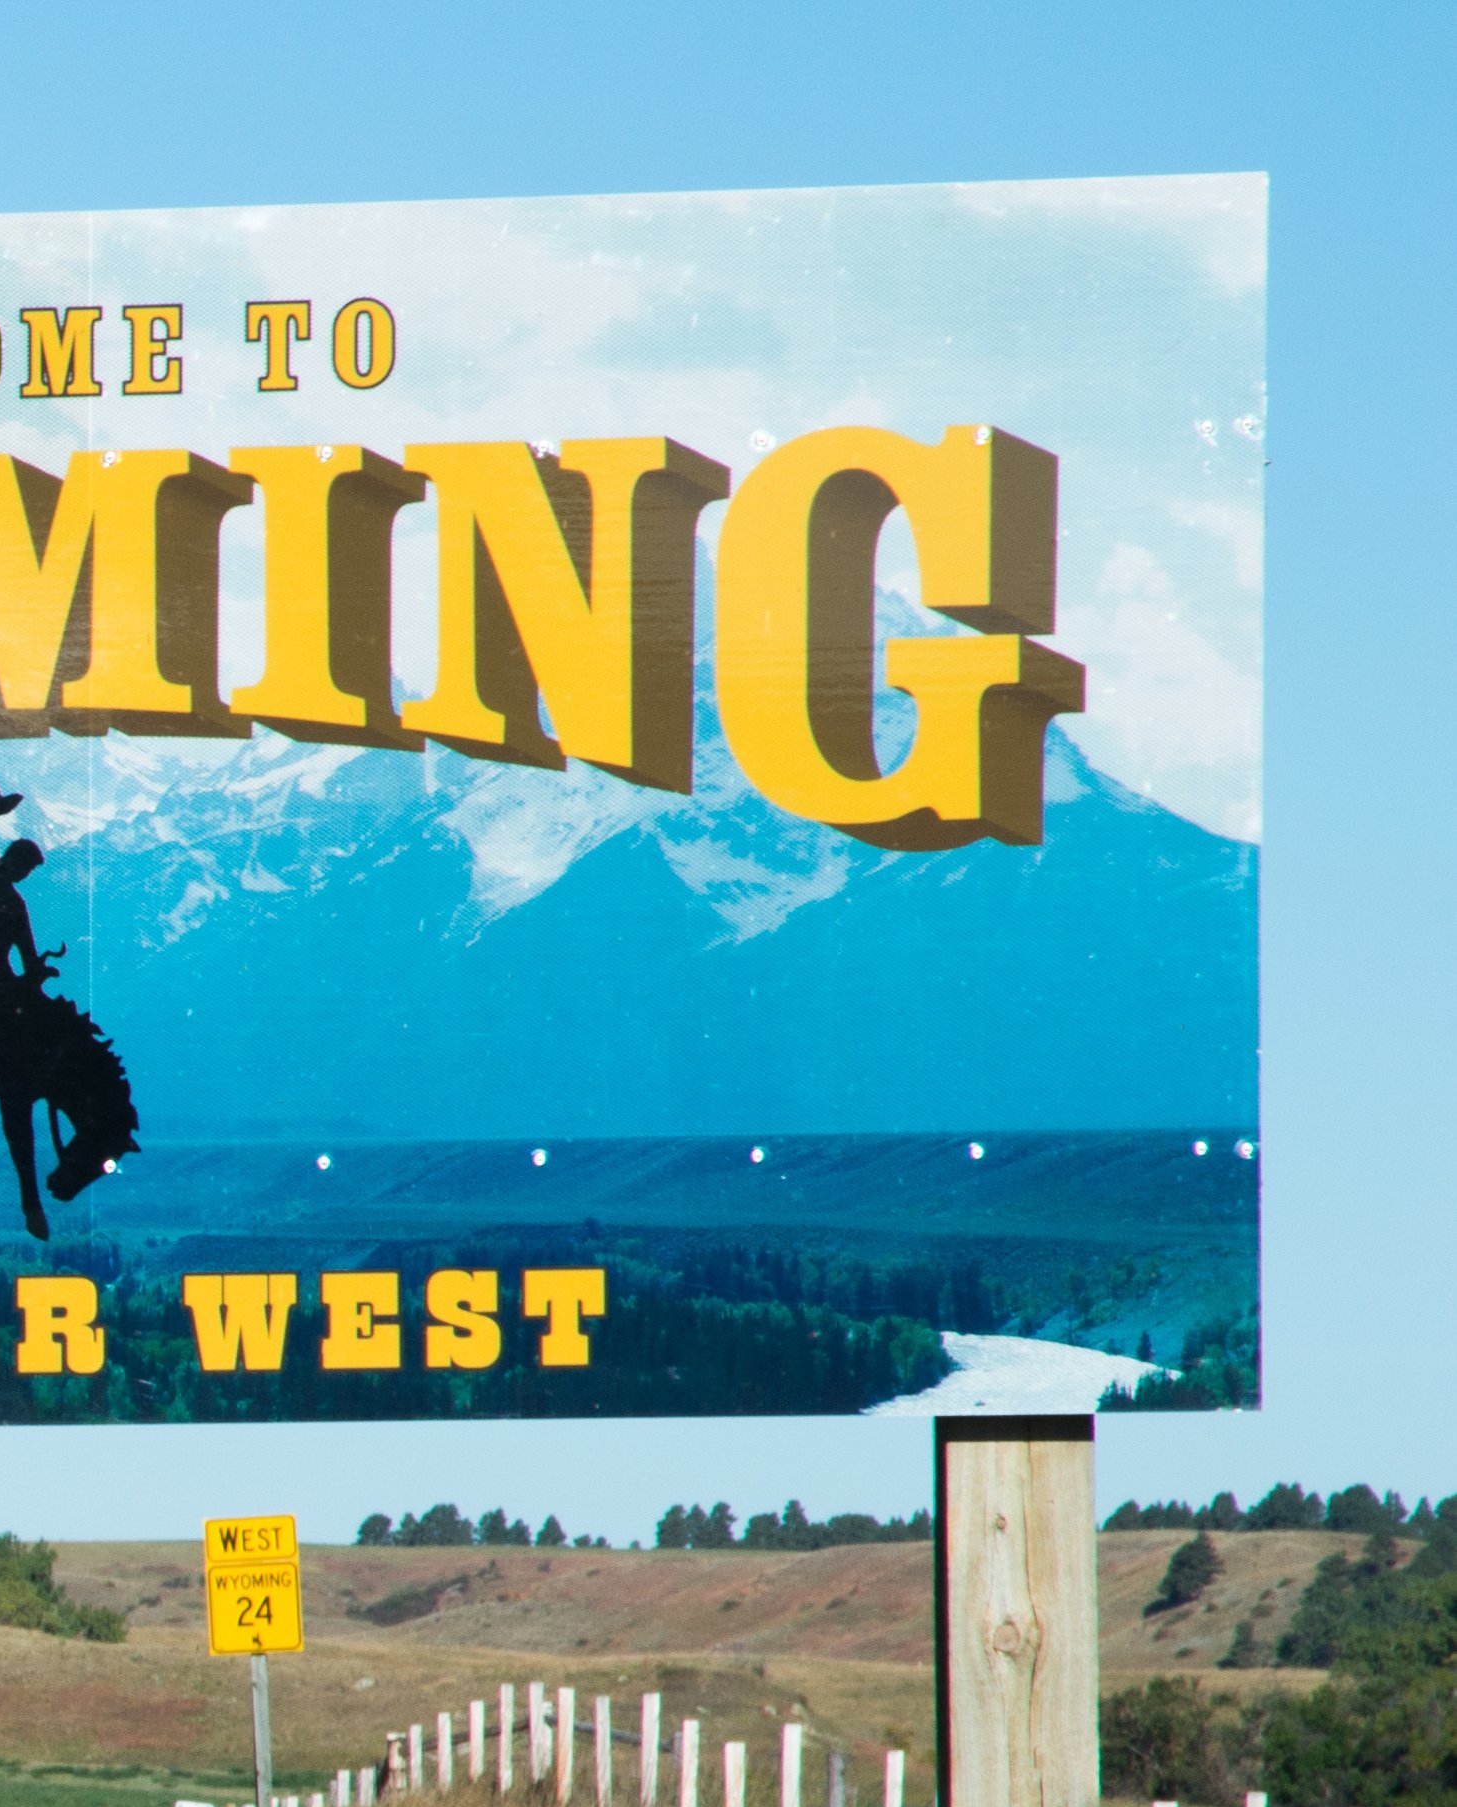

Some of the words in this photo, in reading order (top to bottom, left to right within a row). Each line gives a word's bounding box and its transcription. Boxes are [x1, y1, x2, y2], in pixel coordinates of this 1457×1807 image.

[243, 297, 397, 393] TO
[181, 1266, 606, 1372] WEST
[219, 1526, 281, 1552] WEST
[215, 1572, 291, 1590] WYOMING
[236, 1595, 272, 1626] 24
